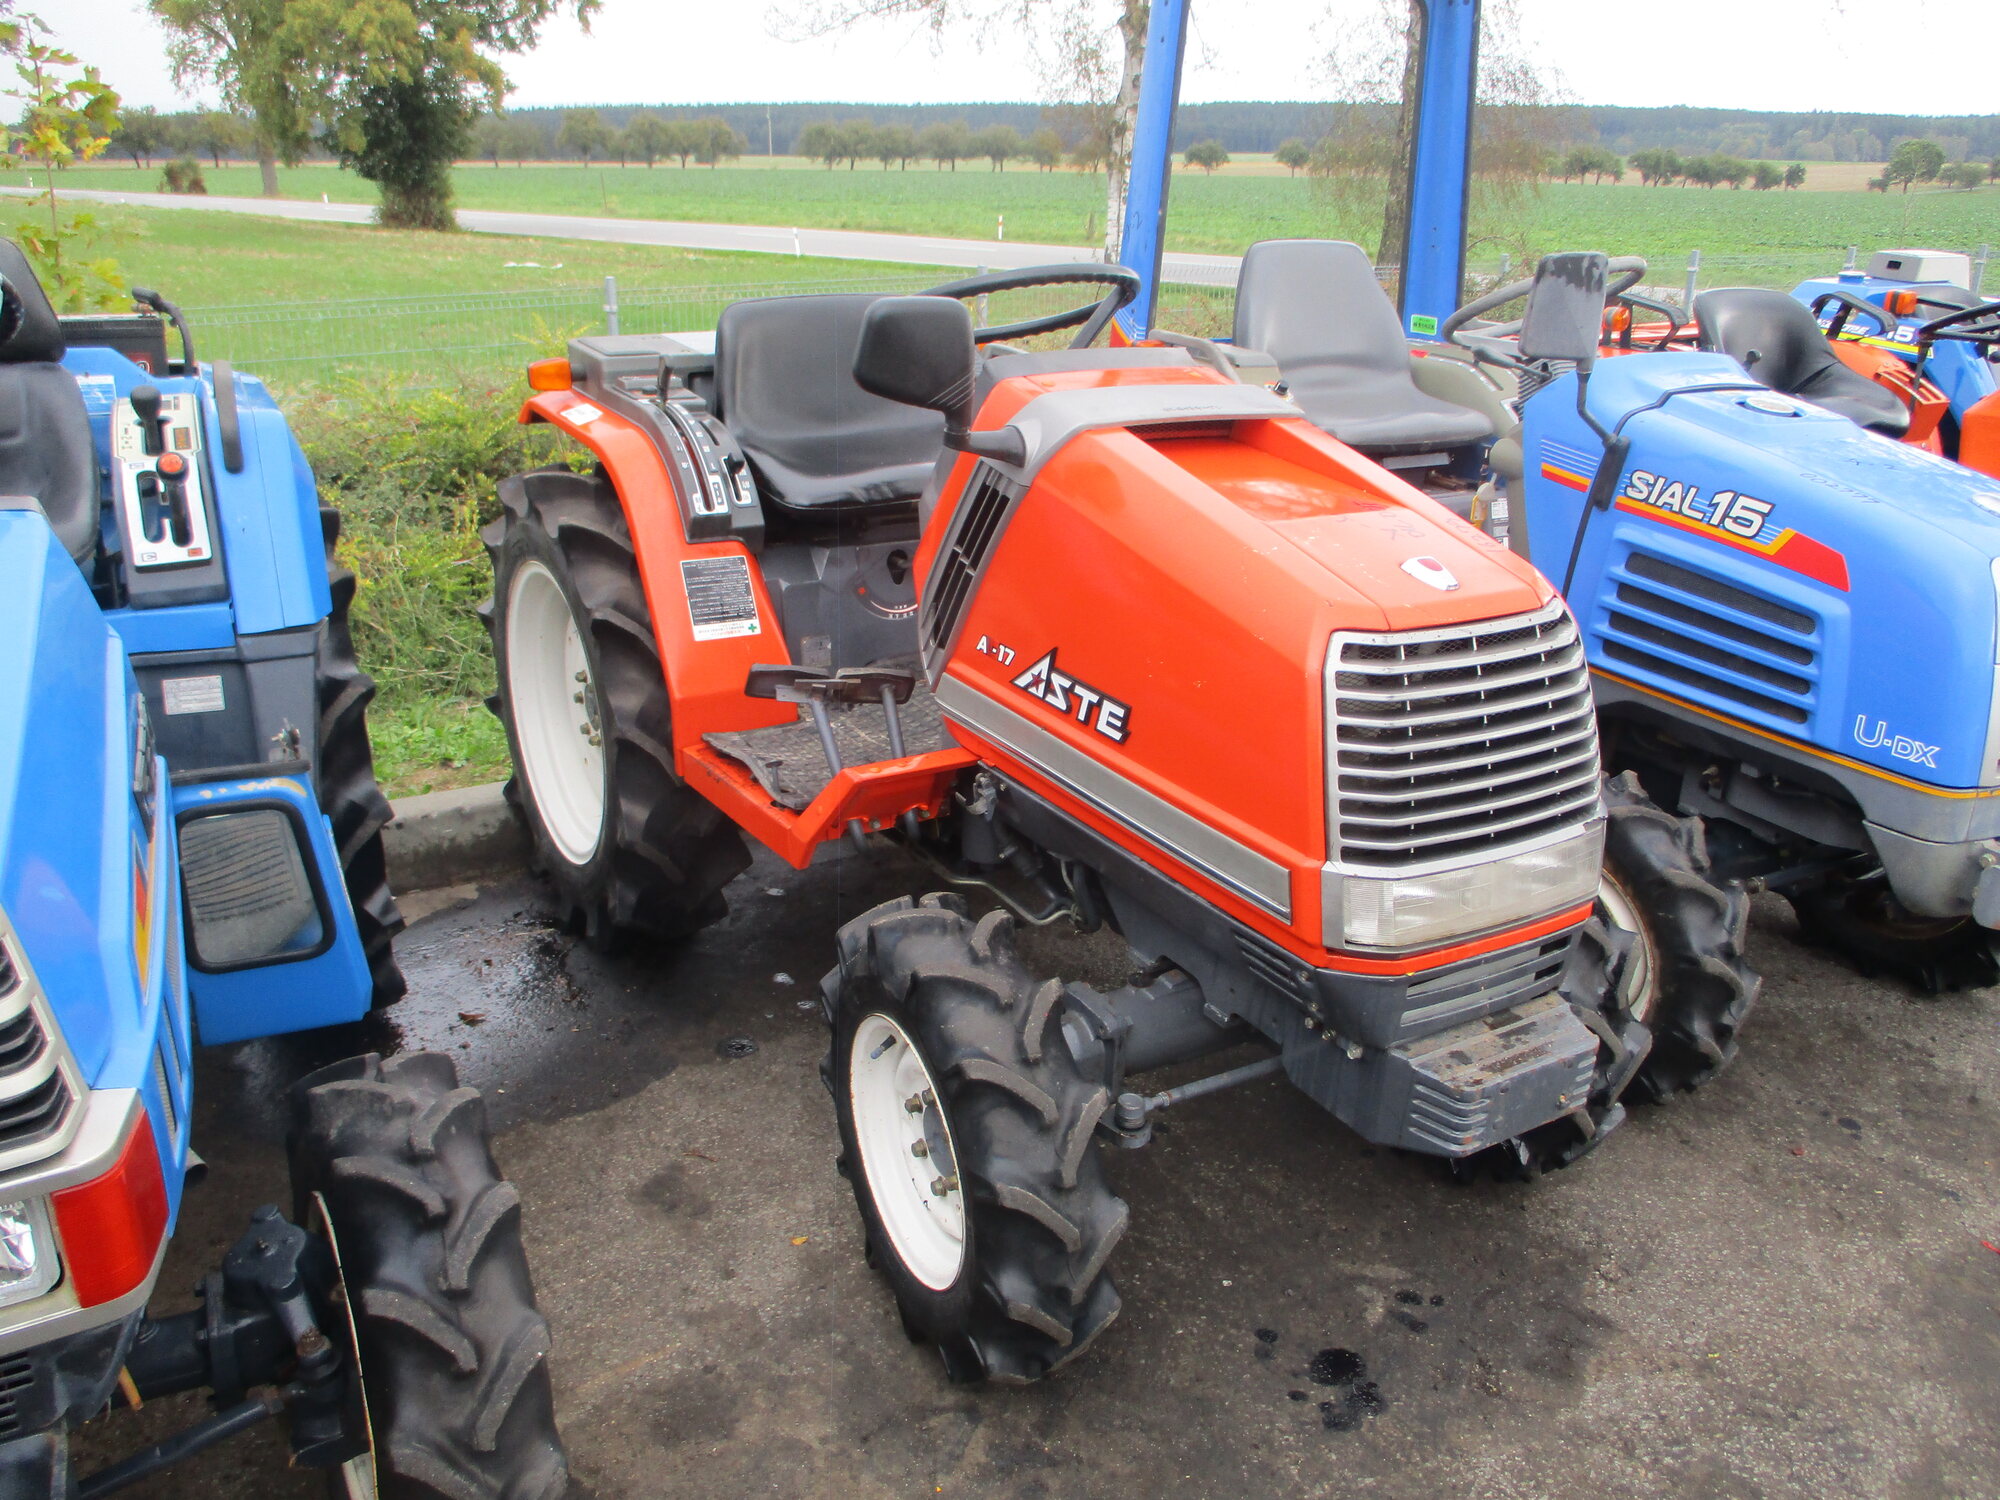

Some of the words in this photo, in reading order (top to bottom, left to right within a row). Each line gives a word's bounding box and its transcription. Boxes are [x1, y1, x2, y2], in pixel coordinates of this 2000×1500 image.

[1624, 469, 1704, 521] SIAL
[975, 634, 1016, 667] A-17
[1010, 648, 1131, 743] ASTE
